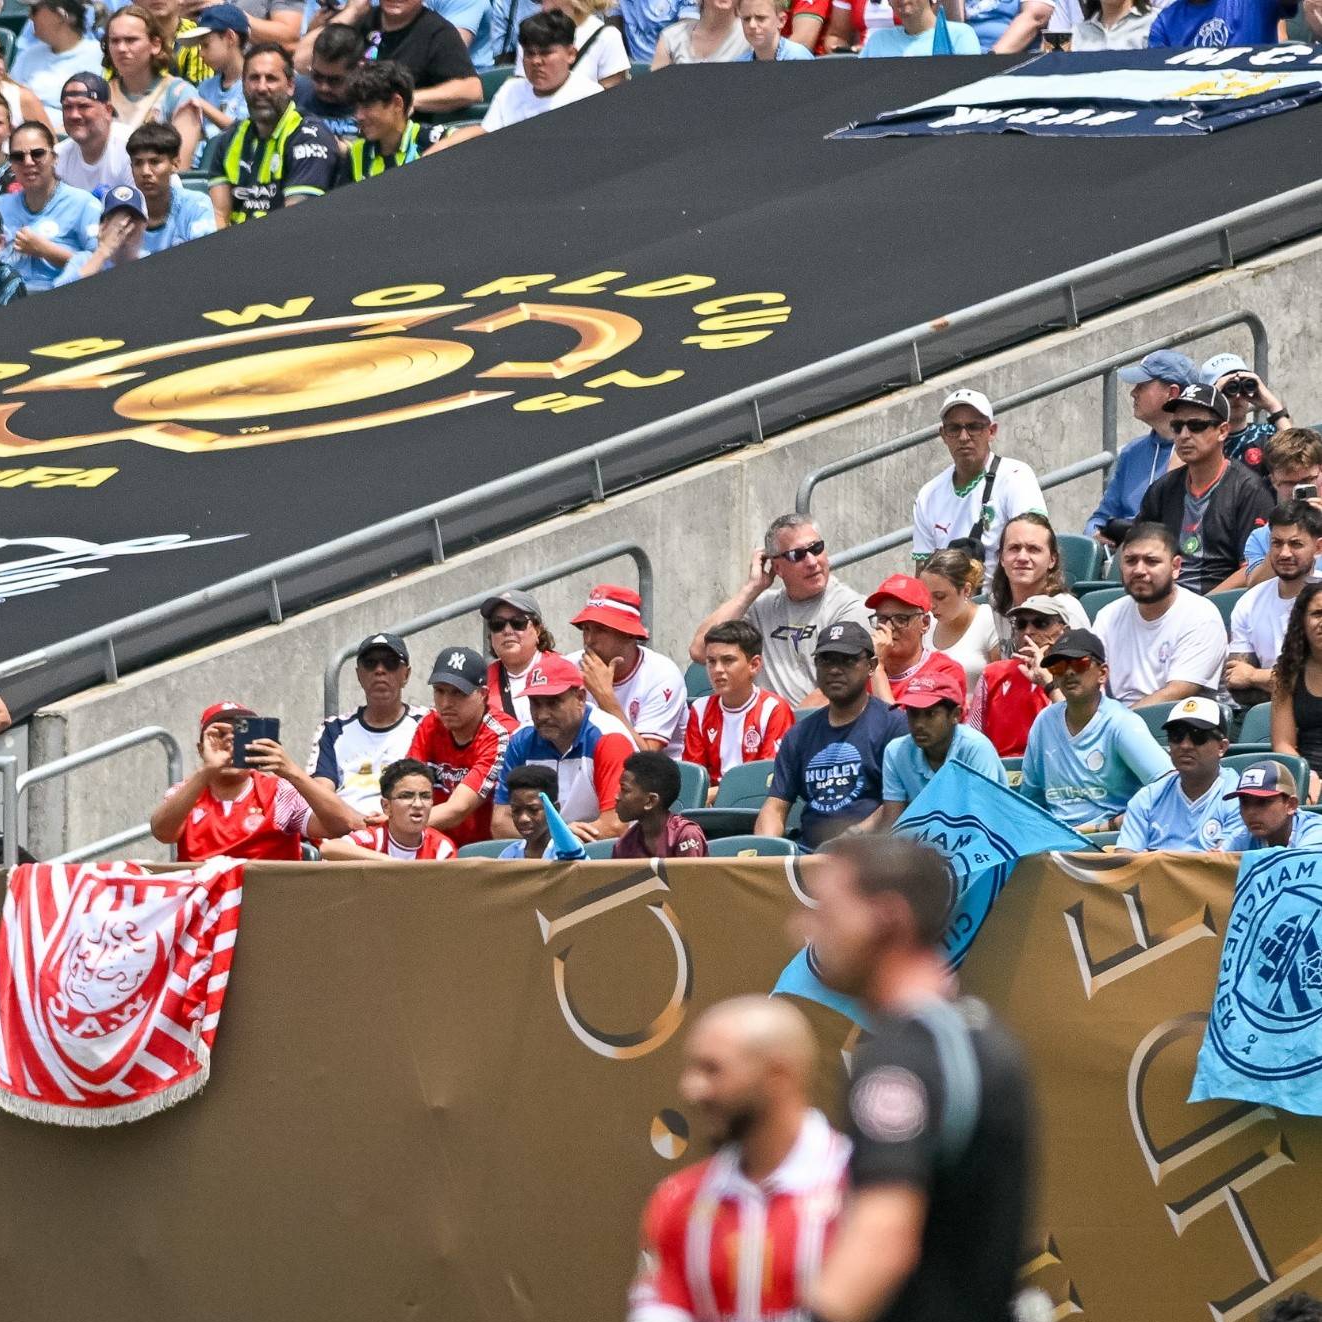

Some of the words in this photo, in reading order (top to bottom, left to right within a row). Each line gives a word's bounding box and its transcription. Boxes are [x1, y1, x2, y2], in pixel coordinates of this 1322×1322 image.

[1165, 46, 1322, 66] MC
[202, 271, 716, 326] WORLD
[681, 292, 792, 349] CUP
[805, 763, 862, 783] HURLEY
